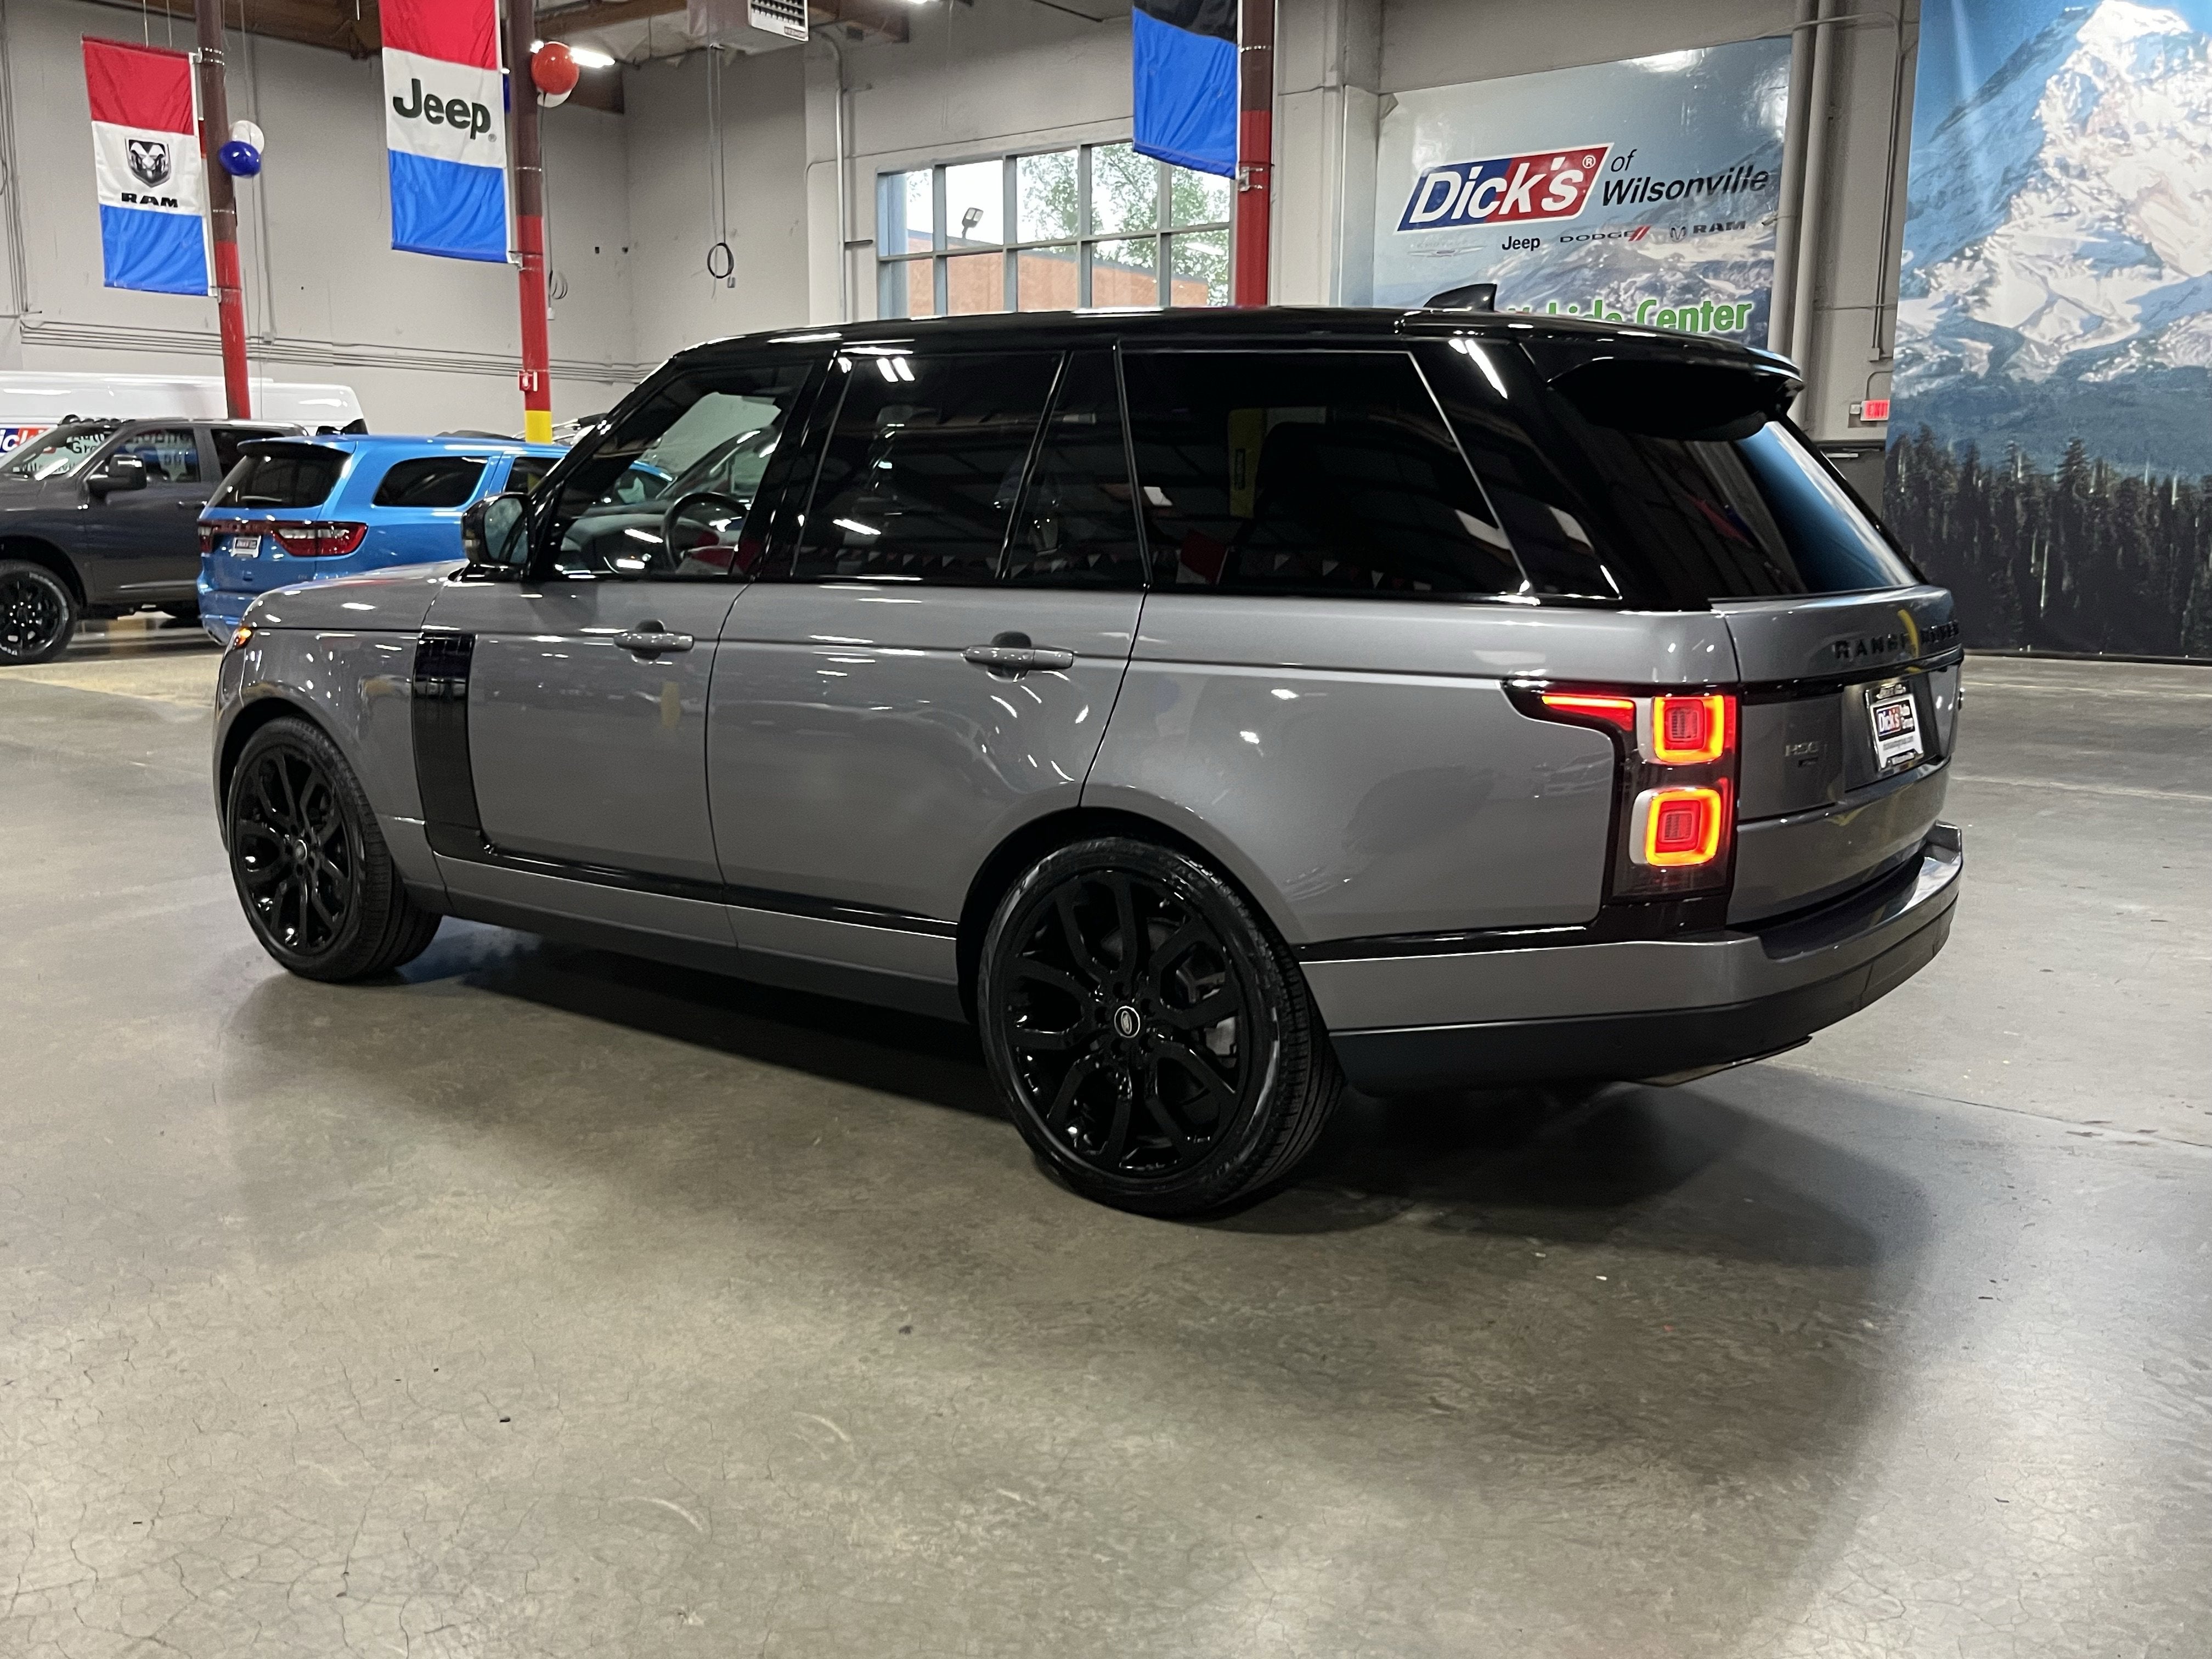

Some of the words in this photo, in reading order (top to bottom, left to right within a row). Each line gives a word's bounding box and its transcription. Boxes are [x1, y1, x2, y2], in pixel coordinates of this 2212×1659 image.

[393, 78, 492, 140] Jeep
[1611, 149, 1637, 172] of
[1602, 165, 1770, 207] Wilsonville
[121, 192, 179, 208] RAM
[1692, 221, 1746, 234] RAM
[1501, 235, 1541, 251] Jeep
[1559, 231, 1635, 244] DODGE
[1637, 299, 1753, 331] Center
